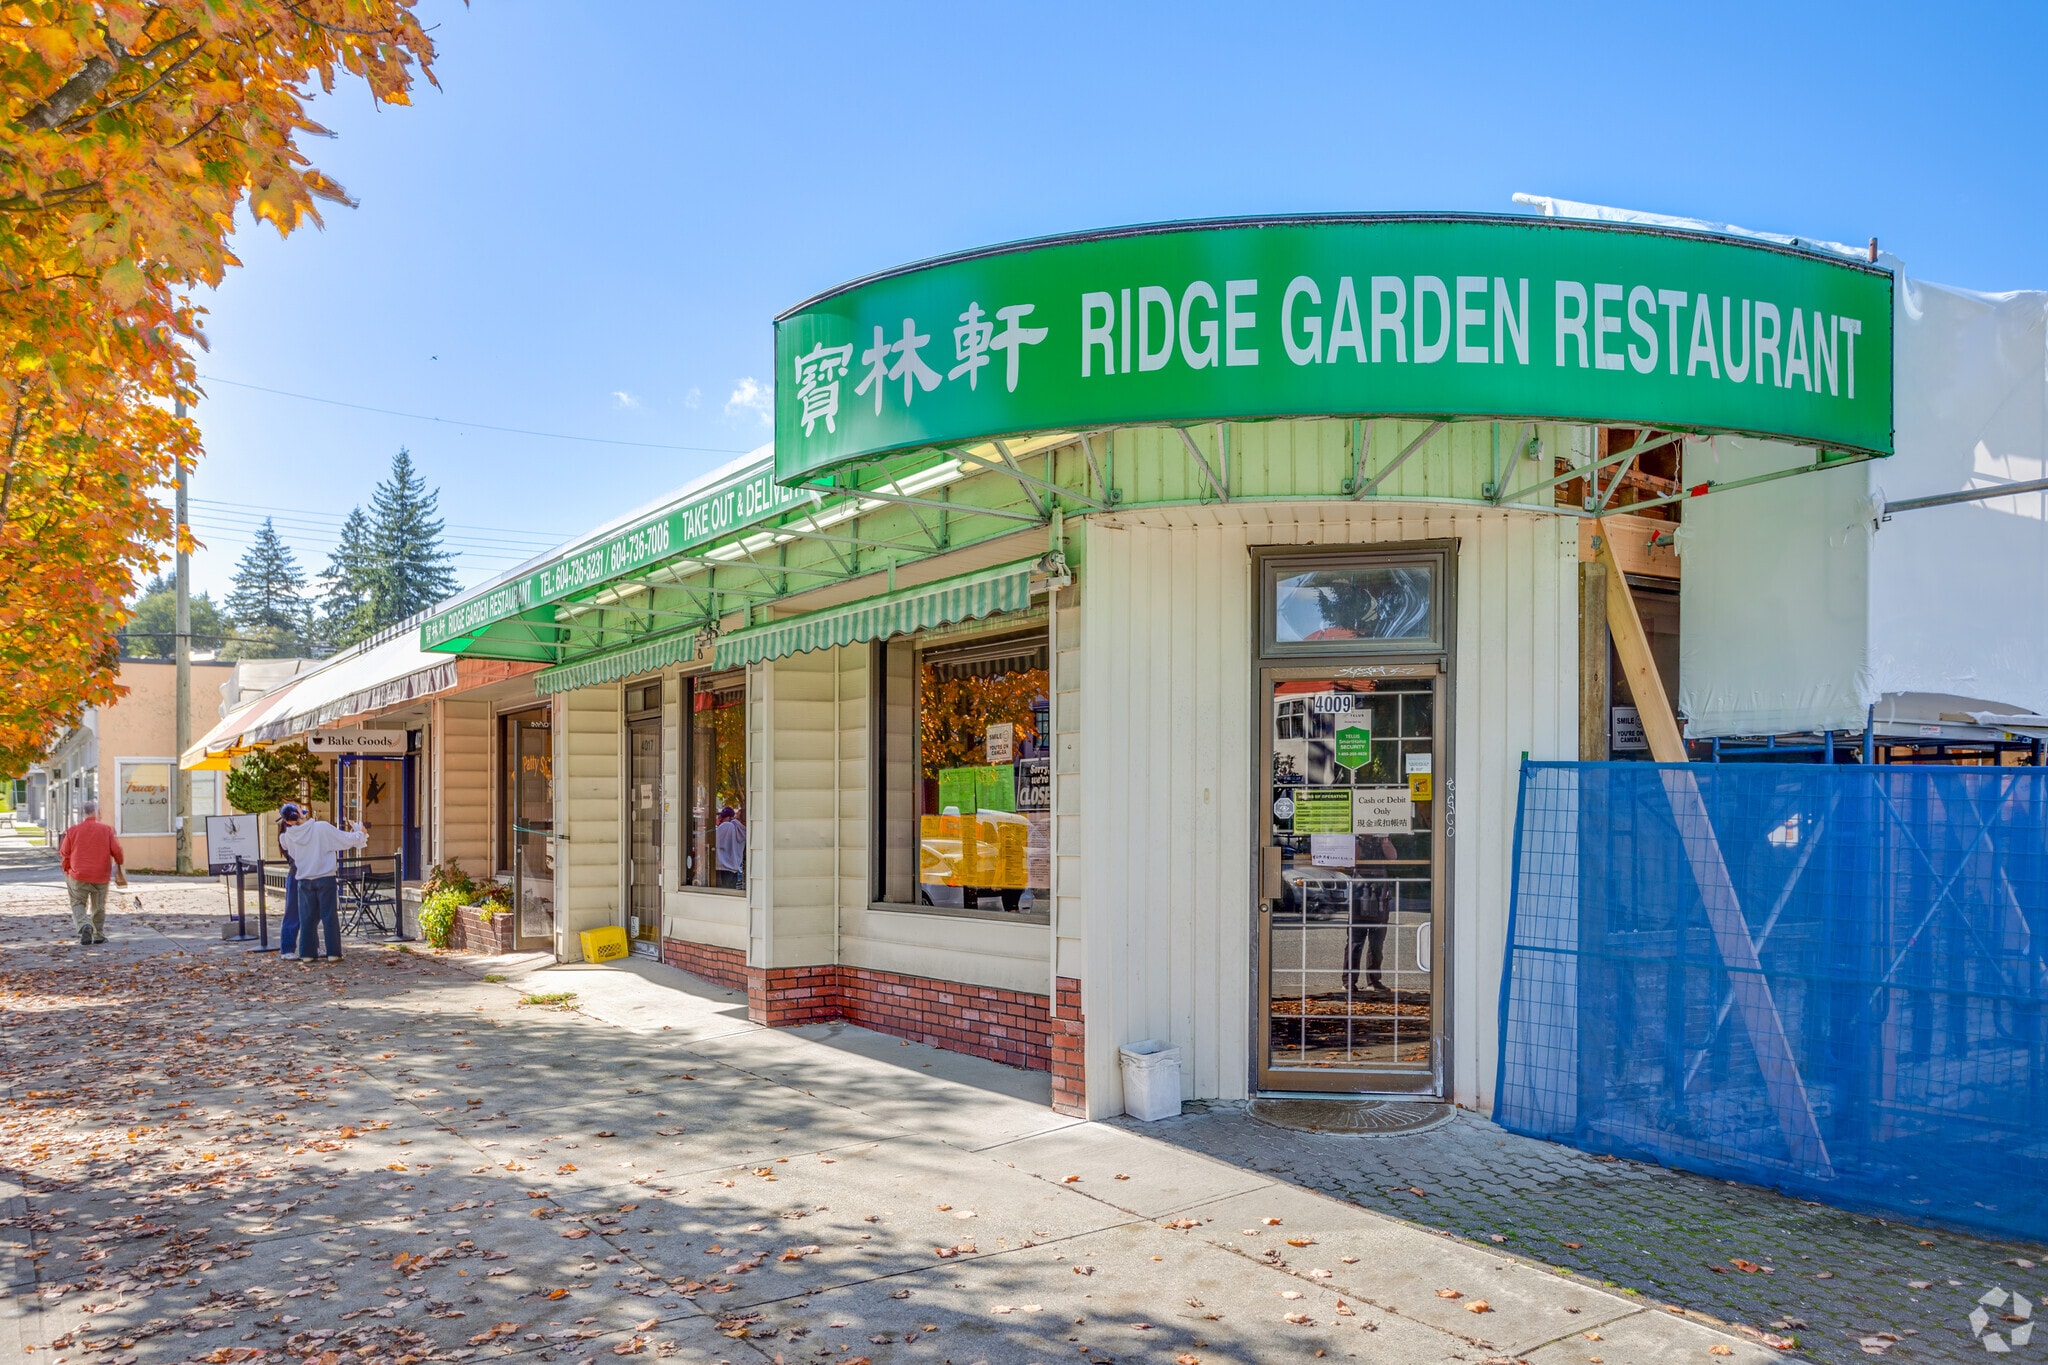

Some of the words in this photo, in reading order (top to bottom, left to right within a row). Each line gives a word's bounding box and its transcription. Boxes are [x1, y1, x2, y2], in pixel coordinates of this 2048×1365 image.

[794, 301, 1049, 438] 寶林軒
[1081, 278, 1260, 378] RIDGE
[1281, 275, 1530, 366] GARDEN
[1555, 279, 1863, 400] RESTAURANT
[448, 607, 465, 634] RIDGE
[466, 597, 489, 628] GARDEN
[489, 579, 532, 617] RESTAURANT
[540, 569, 555, 598] TEL:
[555, 549, 603, 592] 604-736-5231
[610, 520, 670, 572] 604-736-7006
[682, 503, 709, 542] TAKE
[711, 490, 735, 531] OUT
[737, 492, 744, 517] &
[1315, 696, 1351, 712] 4009
[1616, 717, 1635, 725] SMILE
[328, 736, 354, 746] Bake
[357, 736, 393, 746] Goods
[1358, 796, 1376, 804] Cash
[1386, 796, 1406, 804] Debit
[1373, 807, 1391, 815] Only
